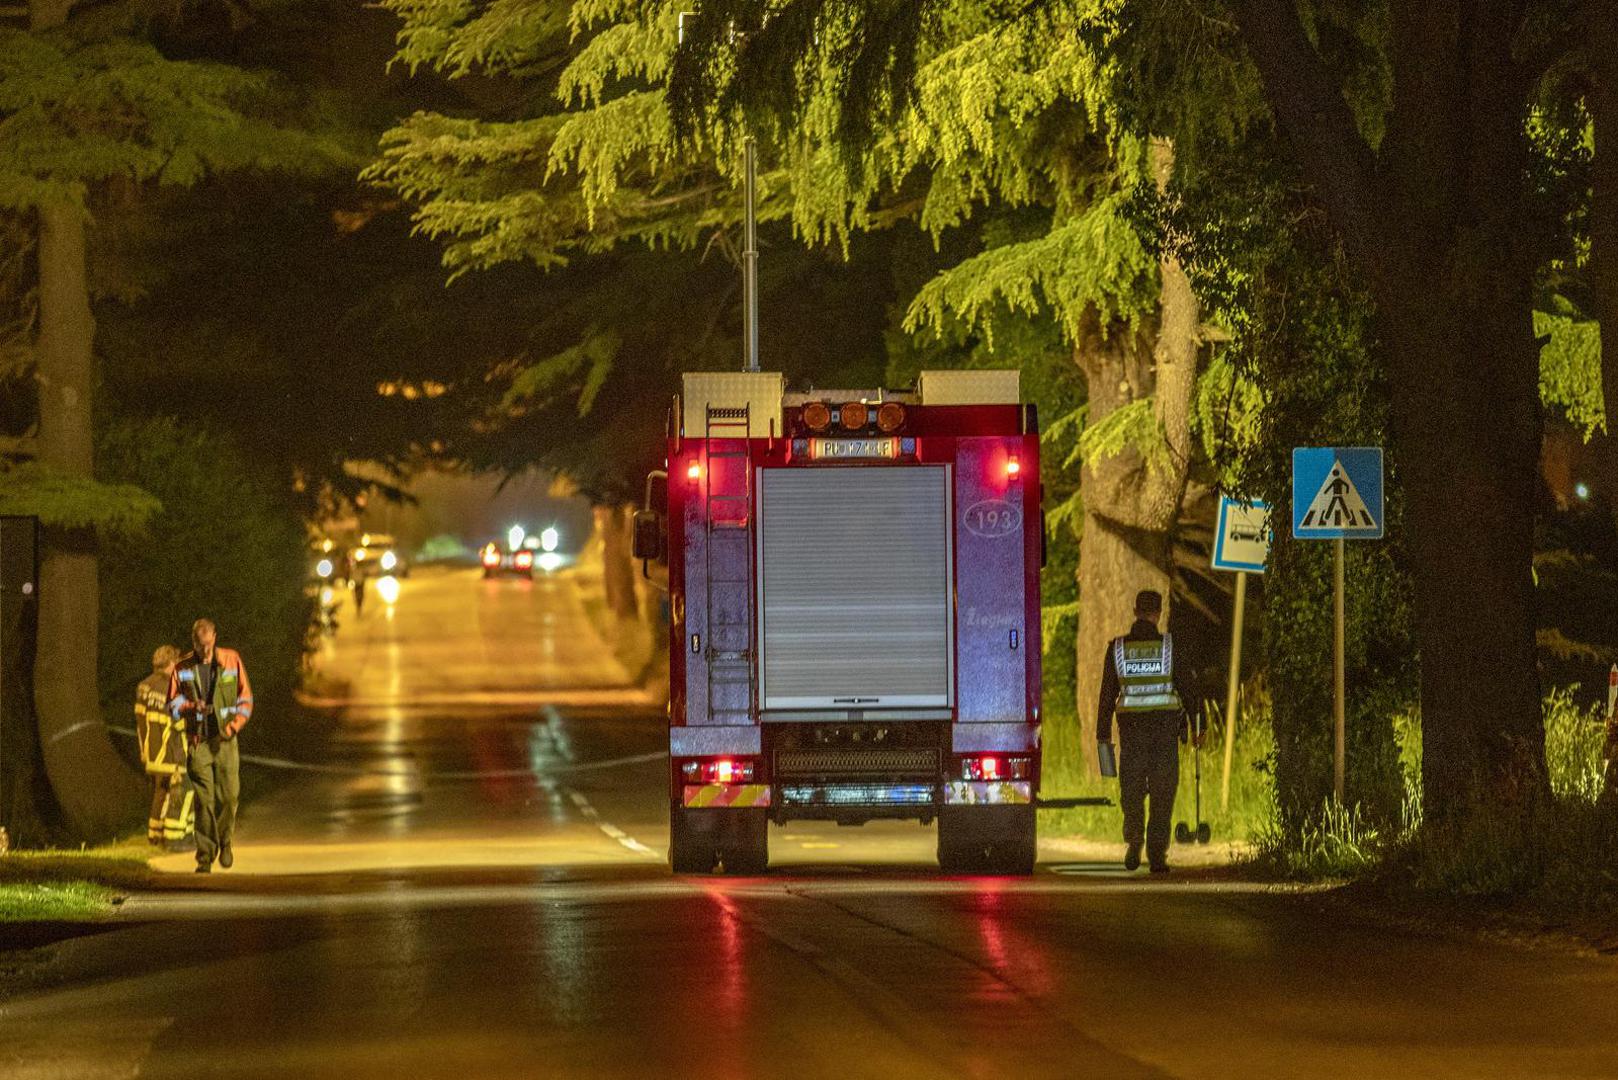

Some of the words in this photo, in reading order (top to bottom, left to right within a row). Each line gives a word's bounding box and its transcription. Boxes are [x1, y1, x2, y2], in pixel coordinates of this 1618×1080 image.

[824, 442, 838, 455] PU
[977, 510, 1011, 529] 193
[1126, 662, 1161, 674] POLICIJA
